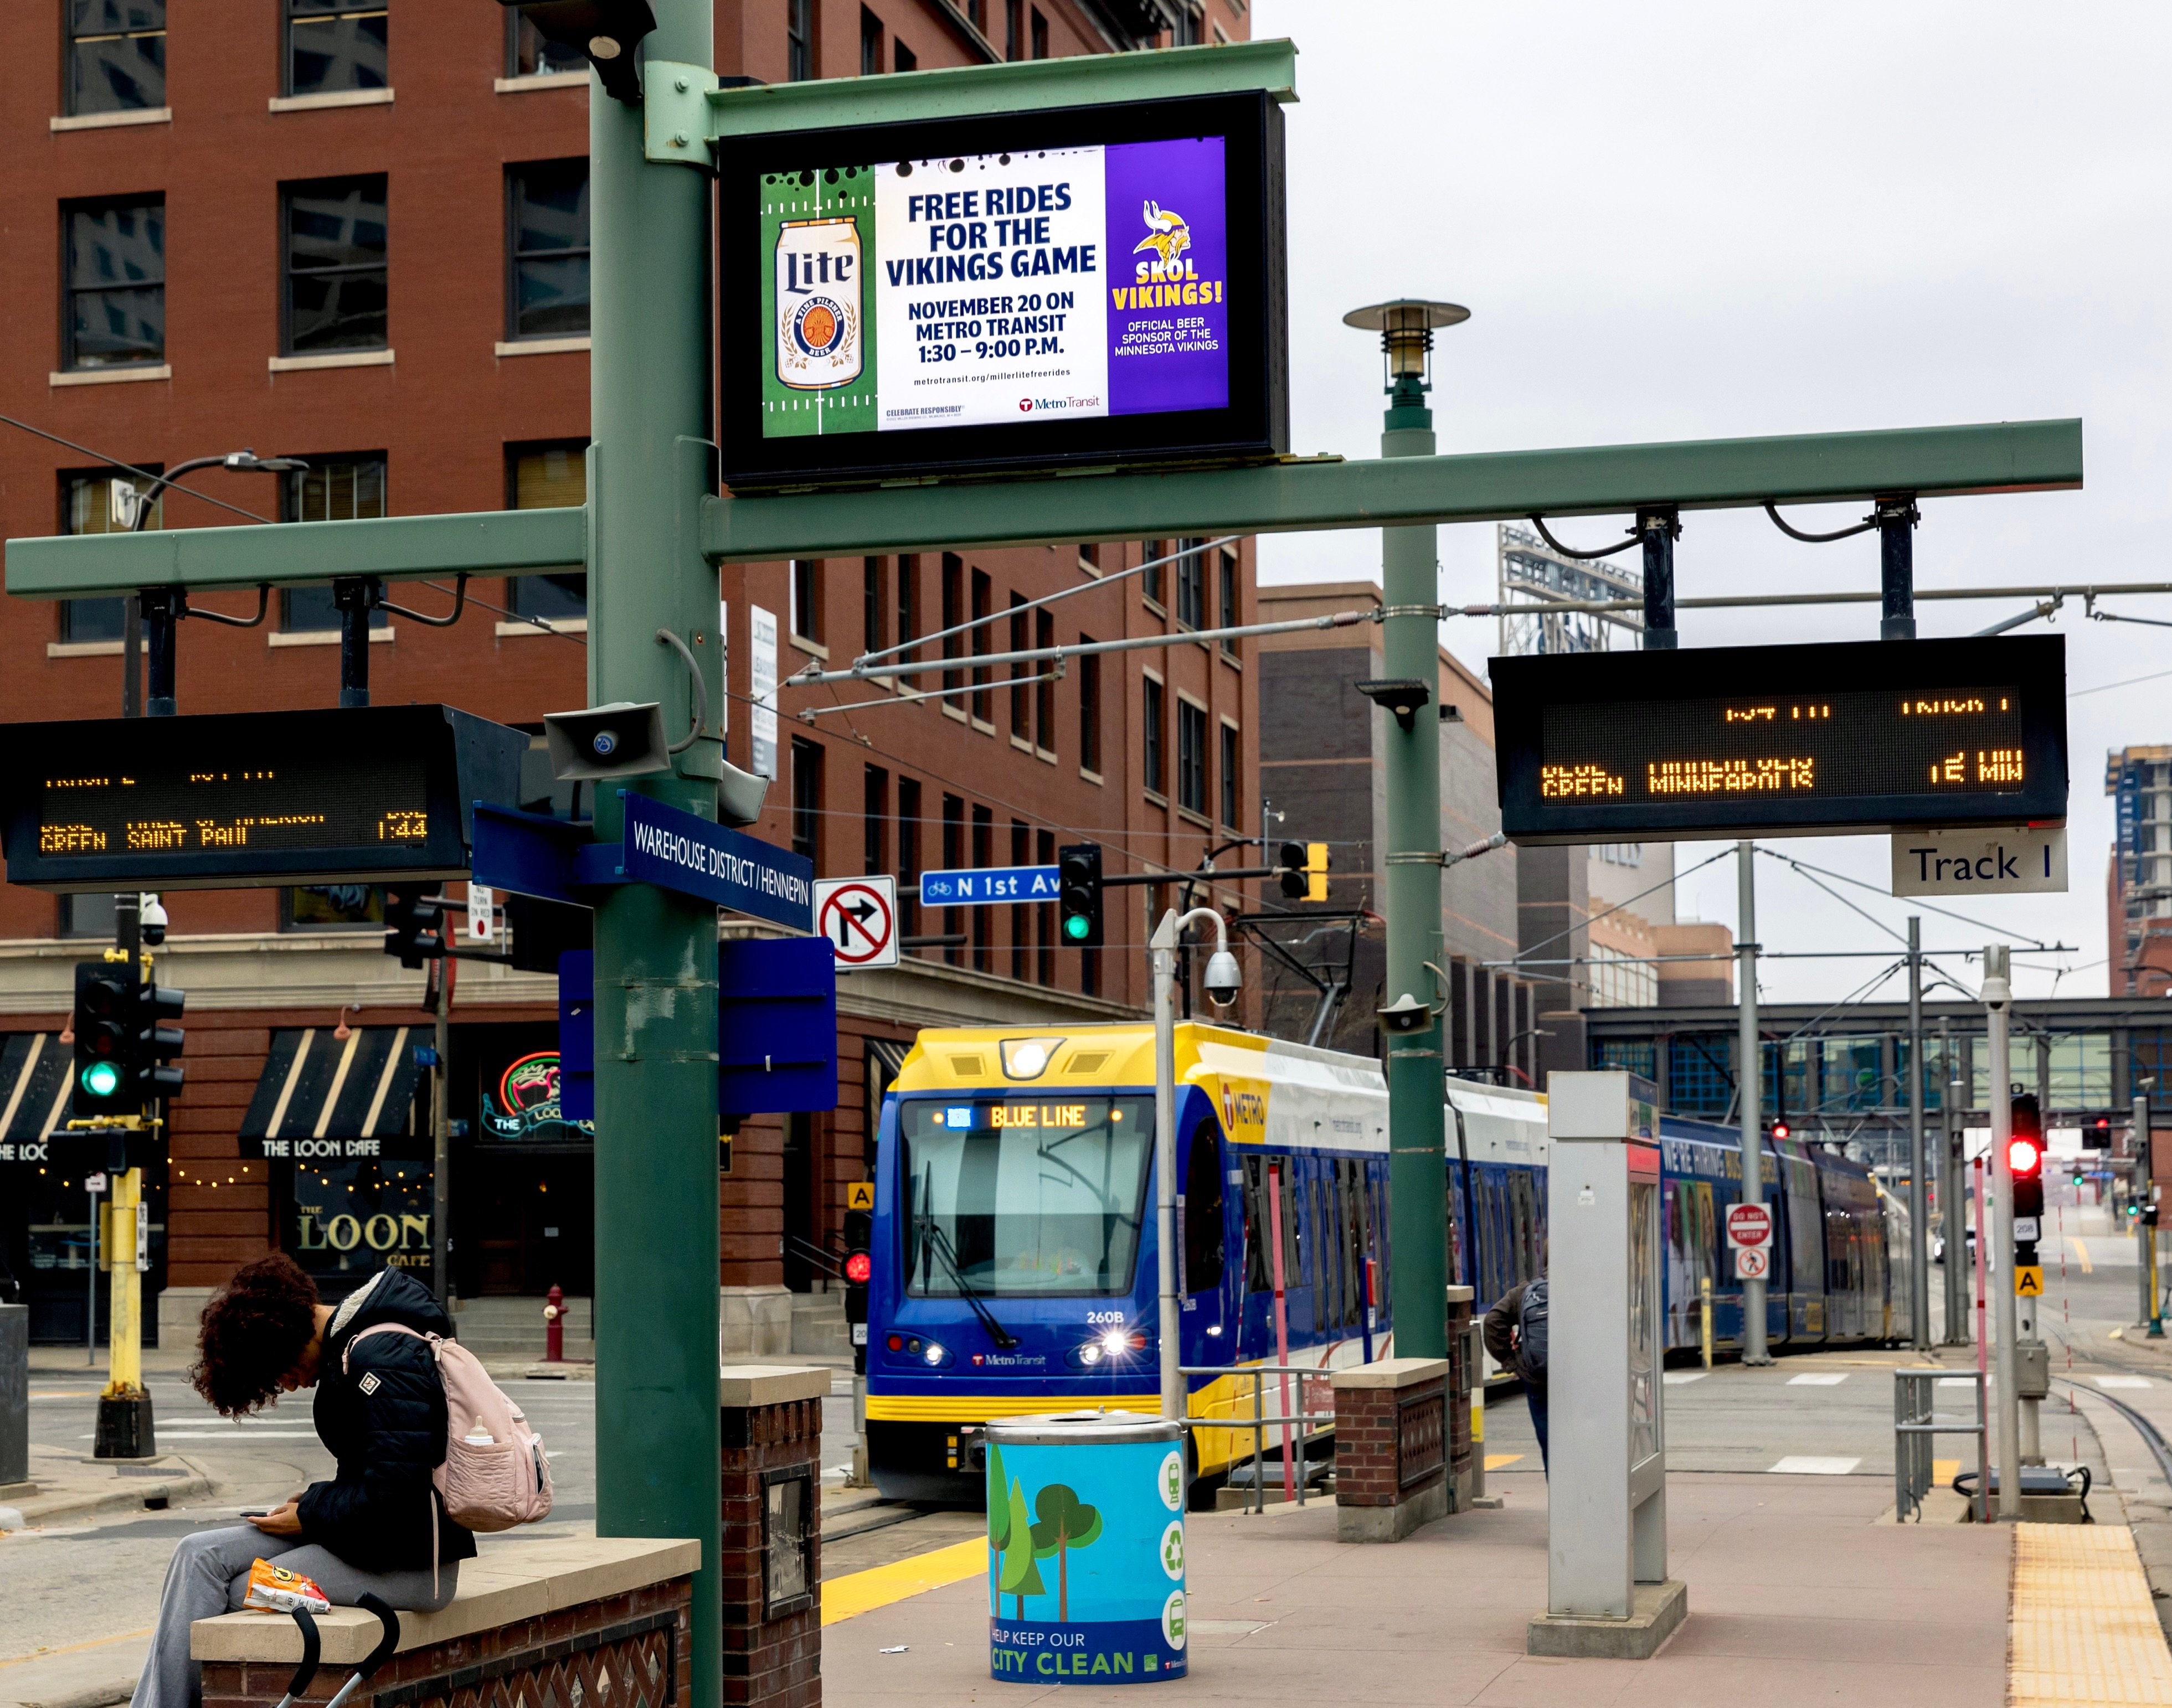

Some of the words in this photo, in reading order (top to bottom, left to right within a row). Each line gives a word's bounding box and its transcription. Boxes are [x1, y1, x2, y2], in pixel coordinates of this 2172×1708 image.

[909, 190, 979, 222] FREE
[986, 183, 1072, 216] RIDES
[930, 222, 987, 252] FOR
[994, 216, 1050, 246] THE
[784, 252, 853, 295] Lite
[886, 251, 1003, 287] VIKINGS
[1011, 244, 1096, 277] GAME
[1136, 259, 1198, 284] SKOL
[908, 296, 1013, 320] NOVEMBER
[1018, 293, 1041, 312] 20
[1046, 291, 1074, 310] ON
[1112, 281, 1222, 310] VIKINGS!
[797, 300, 815, 317] FINE
[817, 298, 843, 322] PILSNER
[916, 320, 981, 341] METRO
[986, 314, 1066, 336] TRANSIT
[1128, 319, 1174, 332] OFFICIAL
[1177, 317, 1205, 328] BEER
[1122, 331, 1171, 344] SPONSOR
[1174, 330, 1187, 340] OF
[1191, 328, 1211, 339] THE
[809, 347, 831, 357] BEER
[919, 344, 956, 363] 1:30
[975, 339, 1020, 359] 9:00
[1025, 337, 1064, 356] P.M.
[1115, 343, 1175, 356] MINNESOTA
[1177, 340, 1218, 352] VIKINGS
[914, 369, 1070, 386] metrotransit.org/millerlitefreerides
[887, 408, 919, 417] CELEBRATE
[634, 821, 706, 872] WAREHOUSE
[709, 848, 754, 888] DISTRICT
[761, 866, 809, 906] HENNEPIN
[1909, 846, 2020, 881] Track
[958, 878, 972, 897] N
[985, 876, 1018, 896] 1st
[494, 1118, 521, 1131] THE
[534, 1107, 563, 1121] LOO
[991, 1106, 1037, 1127] BLUE
[1042, 1106, 1085, 1127] LINE
[1234, 1093, 1264, 1125] METRO
[0, 1144, 15, 1160] HE
[262, 1139, 290, 1157] THE
[294, 1139, 341, 1157] LOON
[346, 1139, 380, 1156] CAFE
[853, 1188, 871, 1204] A
[300, 1205, 323, 1214] THE
[1733, 1212, 1746, 1221] DO
[1747, 1211, 1764, 1220] NOT
[297, 1214, 431, 1251] LOON
[1737, 1230, 1763, 1240] ENTER
[387, 1254, 430, 1267] CAFE
[2019, 1272, 2037, 1291] A
[1087, 1311, 1124, 1324] 260B
[856, 1329, 867, 1338] 20
[991, 1628, 1009, 1643] HELP
[1012, 1632, 1044, 1645] KEEP
[1050, 1633, 1084, 1647] OUR
[992, 1648, 1028, 1673] CITY
[1036, 1652, 1134, 1675] CLEAN
